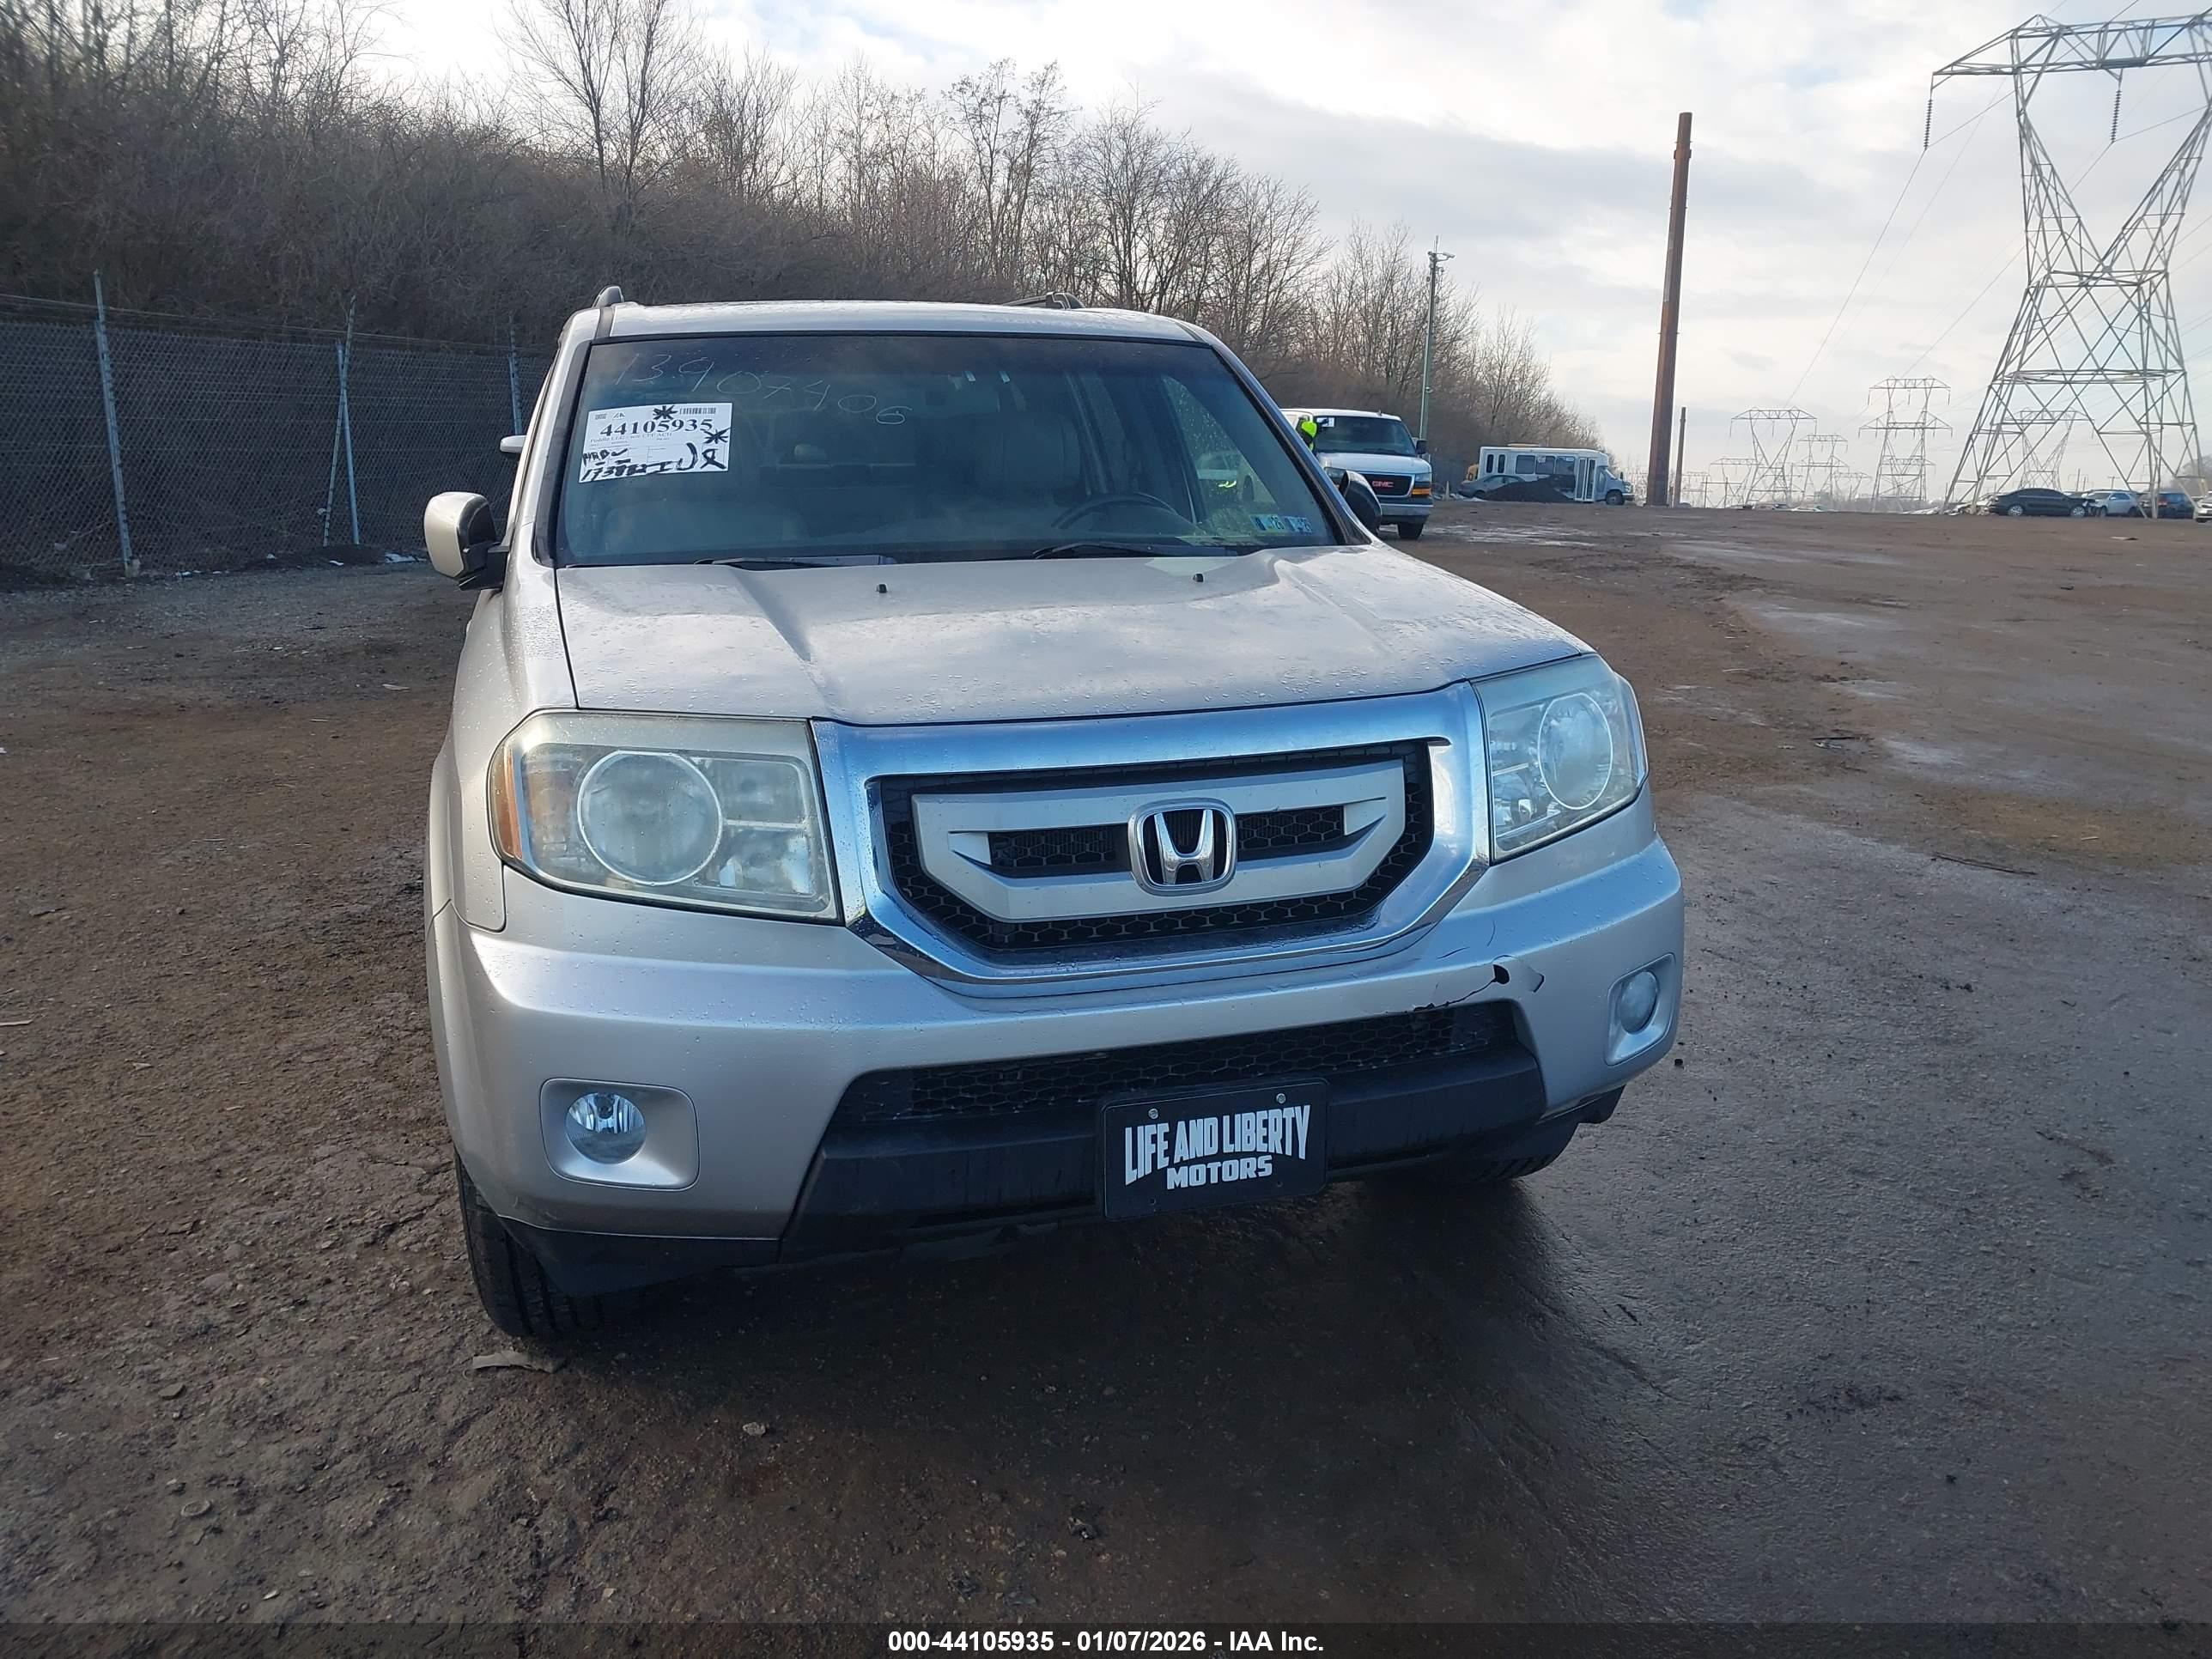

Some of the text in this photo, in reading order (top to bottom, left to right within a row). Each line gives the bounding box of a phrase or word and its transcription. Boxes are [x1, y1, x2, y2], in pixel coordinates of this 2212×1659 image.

[599, 418, 714, 436] 44105935
[1125, 1104, 1311, 1186] LIFE AND LIBERTY
[1166, 1155, 1273, 1190] MOTORS
